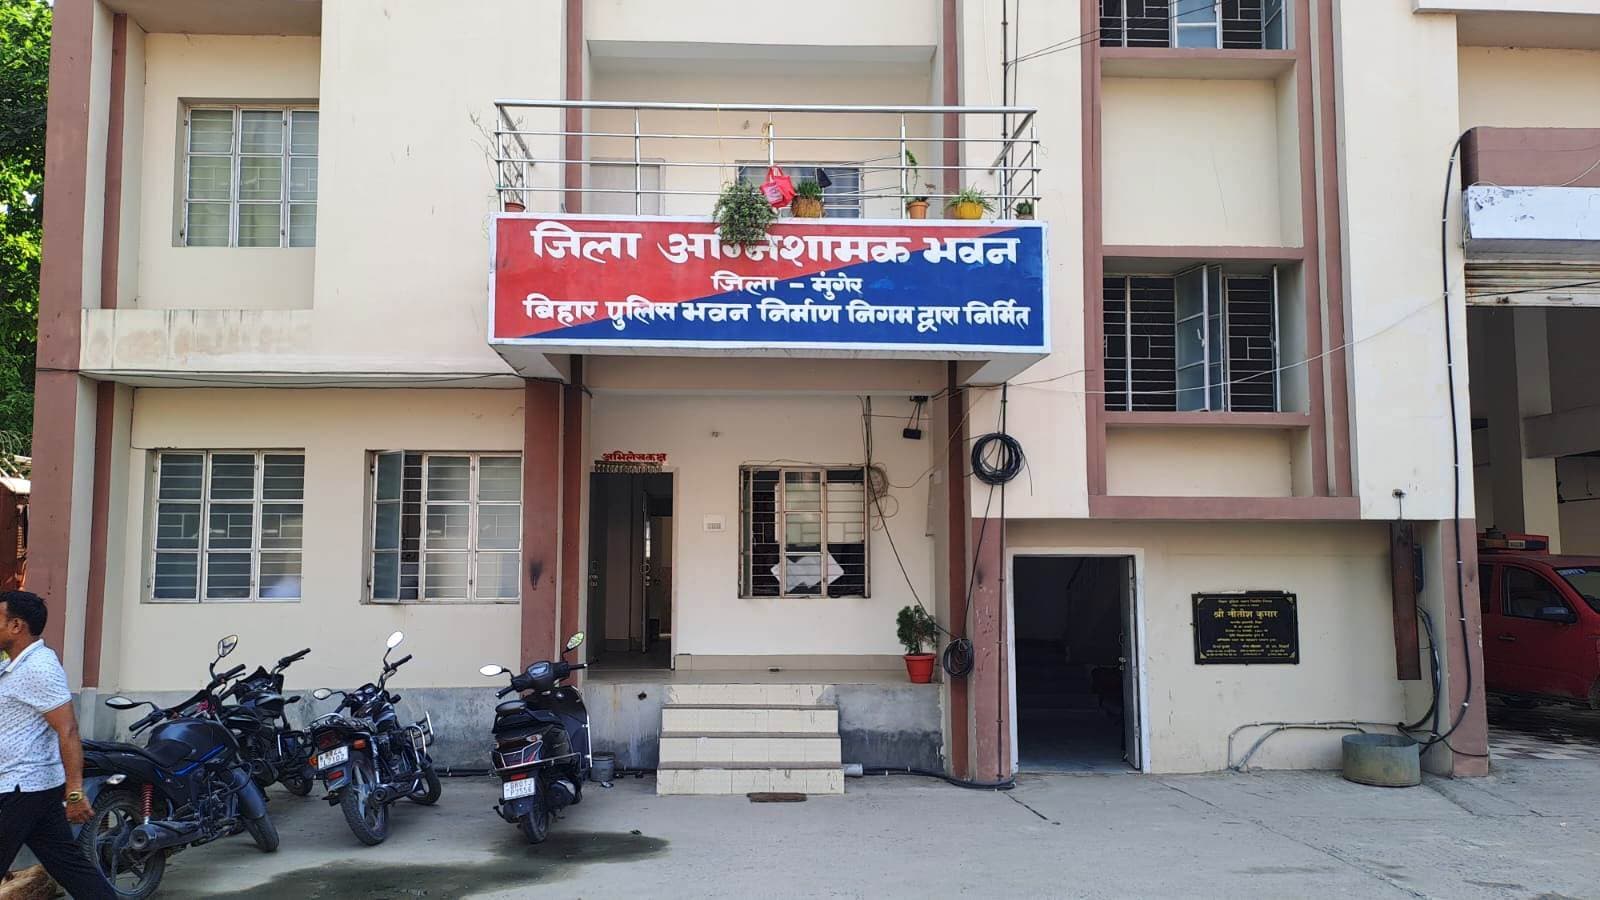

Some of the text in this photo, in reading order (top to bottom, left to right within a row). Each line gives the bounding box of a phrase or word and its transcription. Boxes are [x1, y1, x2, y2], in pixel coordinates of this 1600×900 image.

[530, 220, 643, 264] जिला
[922, 237, 1021, 265] भवन
[711, 270, 778, 296] जिला
[811, 271, 863, 300] मुंगेर
[522, 293, 1031, 333] बिहार पुलिस भवन निर्माण निगम द्वारा निर्मित
